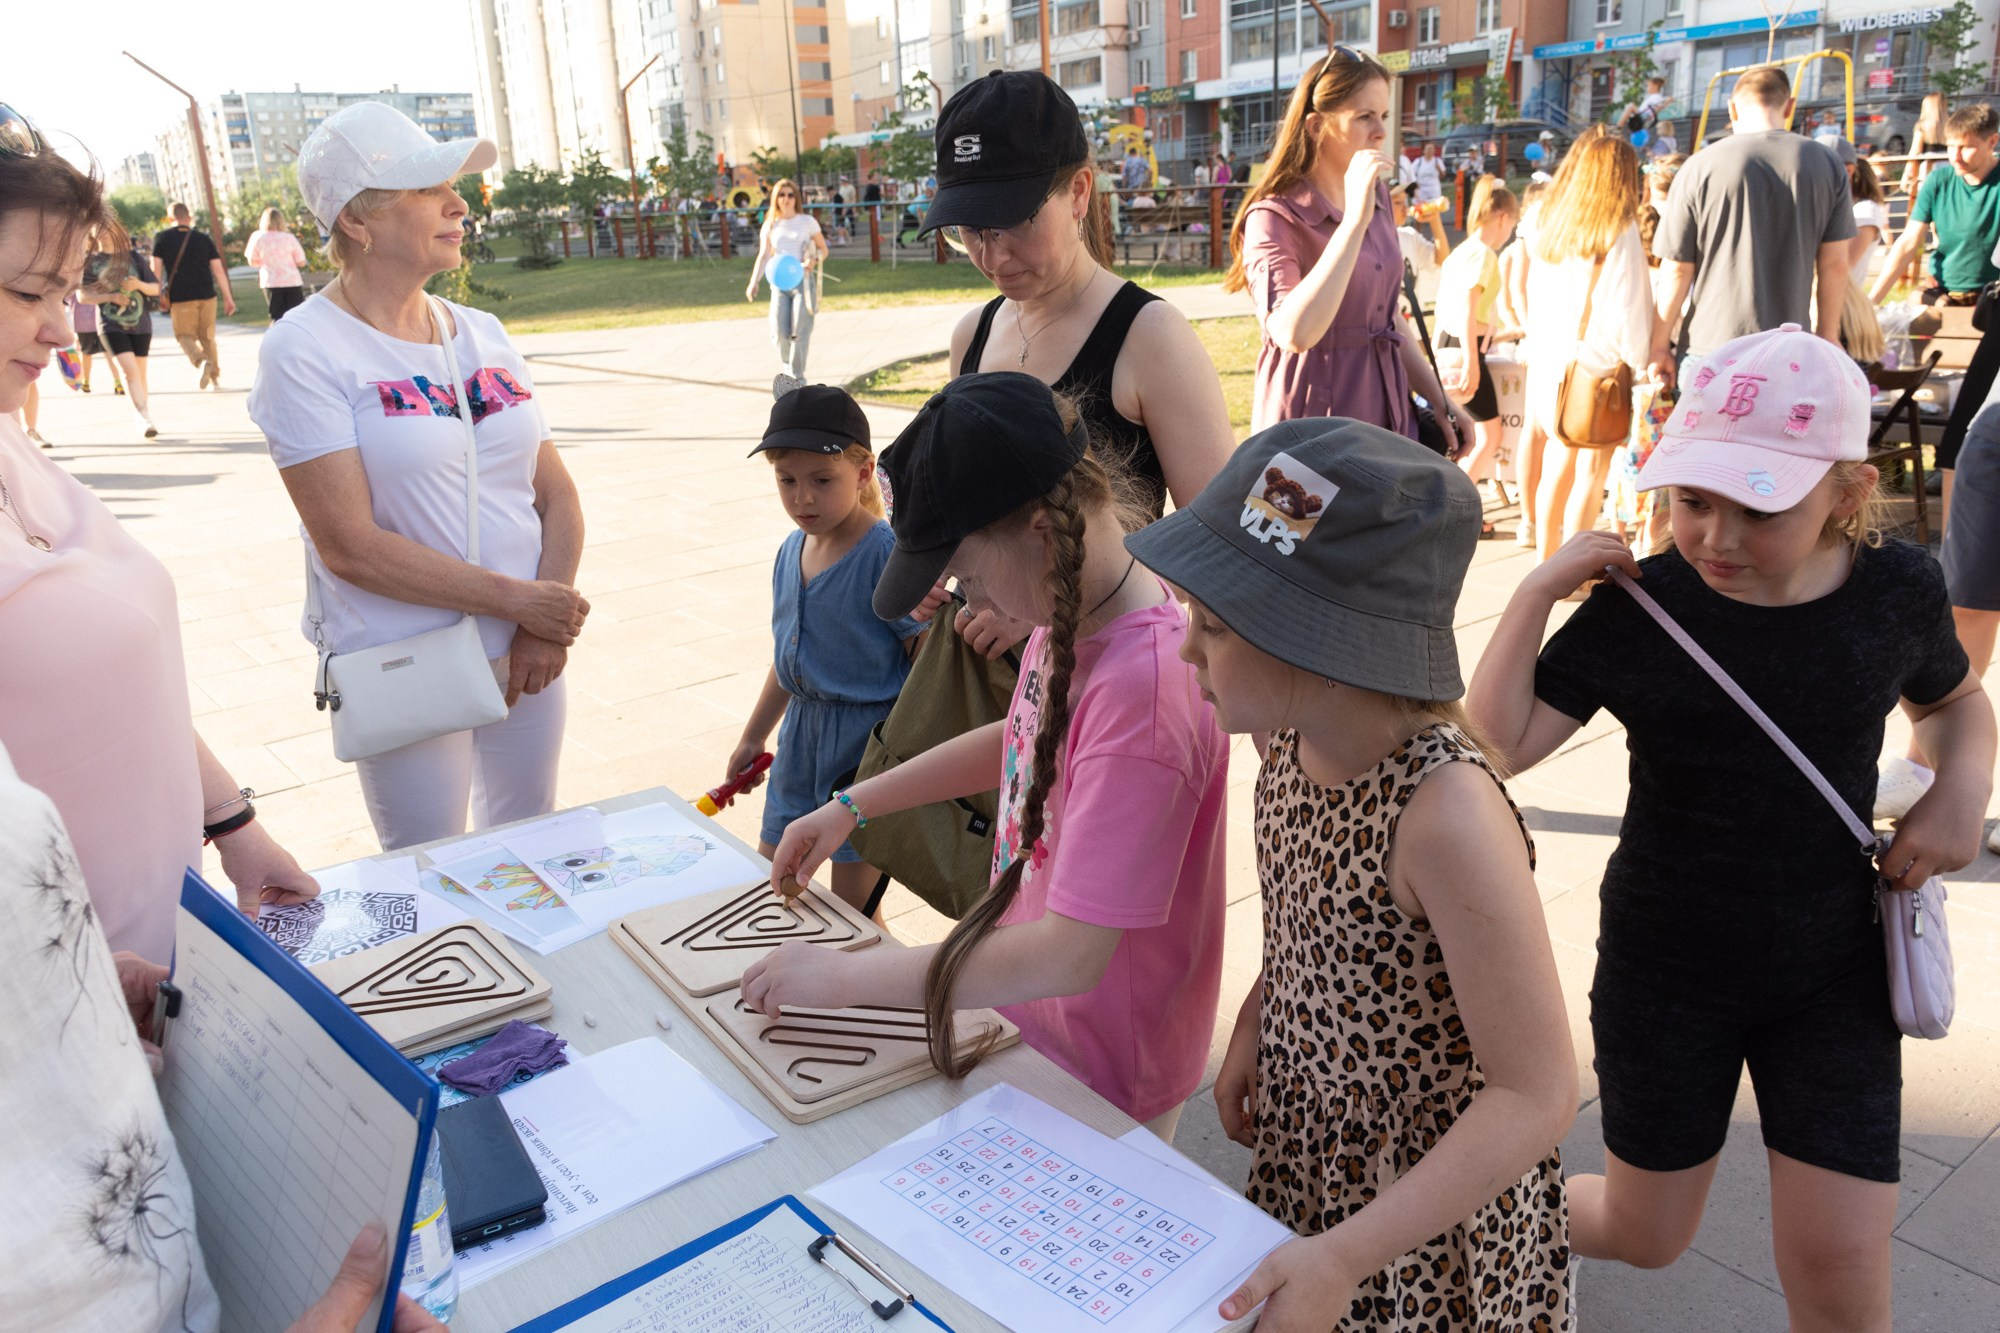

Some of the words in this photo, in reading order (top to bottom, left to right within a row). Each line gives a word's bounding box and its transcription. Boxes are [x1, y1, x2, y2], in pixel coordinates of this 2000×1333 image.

[1840, 6, 1944, 33] WILDBERRIES
[954, 135, 982, 155] S
[1240, 500, 1301, 556] VLPS
[394, 897, 415, 913] 39
[393, 913, 414, 930] 50
[982, 1126, 995, 1134] 7
[1000, 1135, 1017, 1146] 12
[936, 1148, 954, 1160] 15
[979, 1148, 997, 1159] 22
[1021, 1147, 1038, 1158] 18
[914, 1162, 933, 1174] 23
[955, 1161, 976, 1172] 25
[1041, 1159, 1061, 1171] 25
[894, 1177, 906, 1185] 6
[936, 1176, 949, 1185] 5
[977, 1173, 994, 1186] 13
[1067, 1174, 1079, 1182] 6
[913, 1190, 926, 1199] 8
[958, 1189, 970, 1198] 3
[998, 1187, 1015, 1199] 16
[1040, 1187, 1059, 1198] 17
[1085, 1184, 1103, 1196] 19
[978, 1202, 992, 1212] 2
[1020, 1200, 1040, 1213] 21
[1064, 1199, 1082, 1211] 10
[1112, 1198, 1124, 1206] 8
[930, 1203, 948, 1214] 17
[1134, 1209, 1148, 1219] 5
[953, 1215, 970, 1229] 16
[997, 1215, 1017, 1228] 21
[1042, 1212, 1060, 1226] 12
[1091, 1213, 1101, 1222] 1
[1115, 1225, 1125, 1233] 1
[1155, 1219, 1174, 1232] 10
[975, 1230, 991, 1243] 11
[1019, 1228, 1040, 1241] 24
[1064, 1226, 1083, 1239] 14
[1088, 1238, 1110, 1252] 20
[1134, 1235, 1153, 1248] 14
[1180, 1232, 1199, 1246] 13
[999, 1246, 1012, 1255] 9
[1042, 1241, 1063, 1255] 23
[1112, 1251, 1134, 1265] 20
[1159, 1247, 1181, 1263] 22
[1019, 1258, 1037, 1271] 19
[1069, 1257, 1082, 1266] 3
[1043, 1272, 1061, 1285] 11
[1093, 1269, 1108, 1280] 2
[1141, 1268, 1154, 1277] 9
[1066, 1285, 1088, 1300] 24
[1114, 1282, 1134, 1297] 18
[1090, 1300, 1111, 1315] 15
